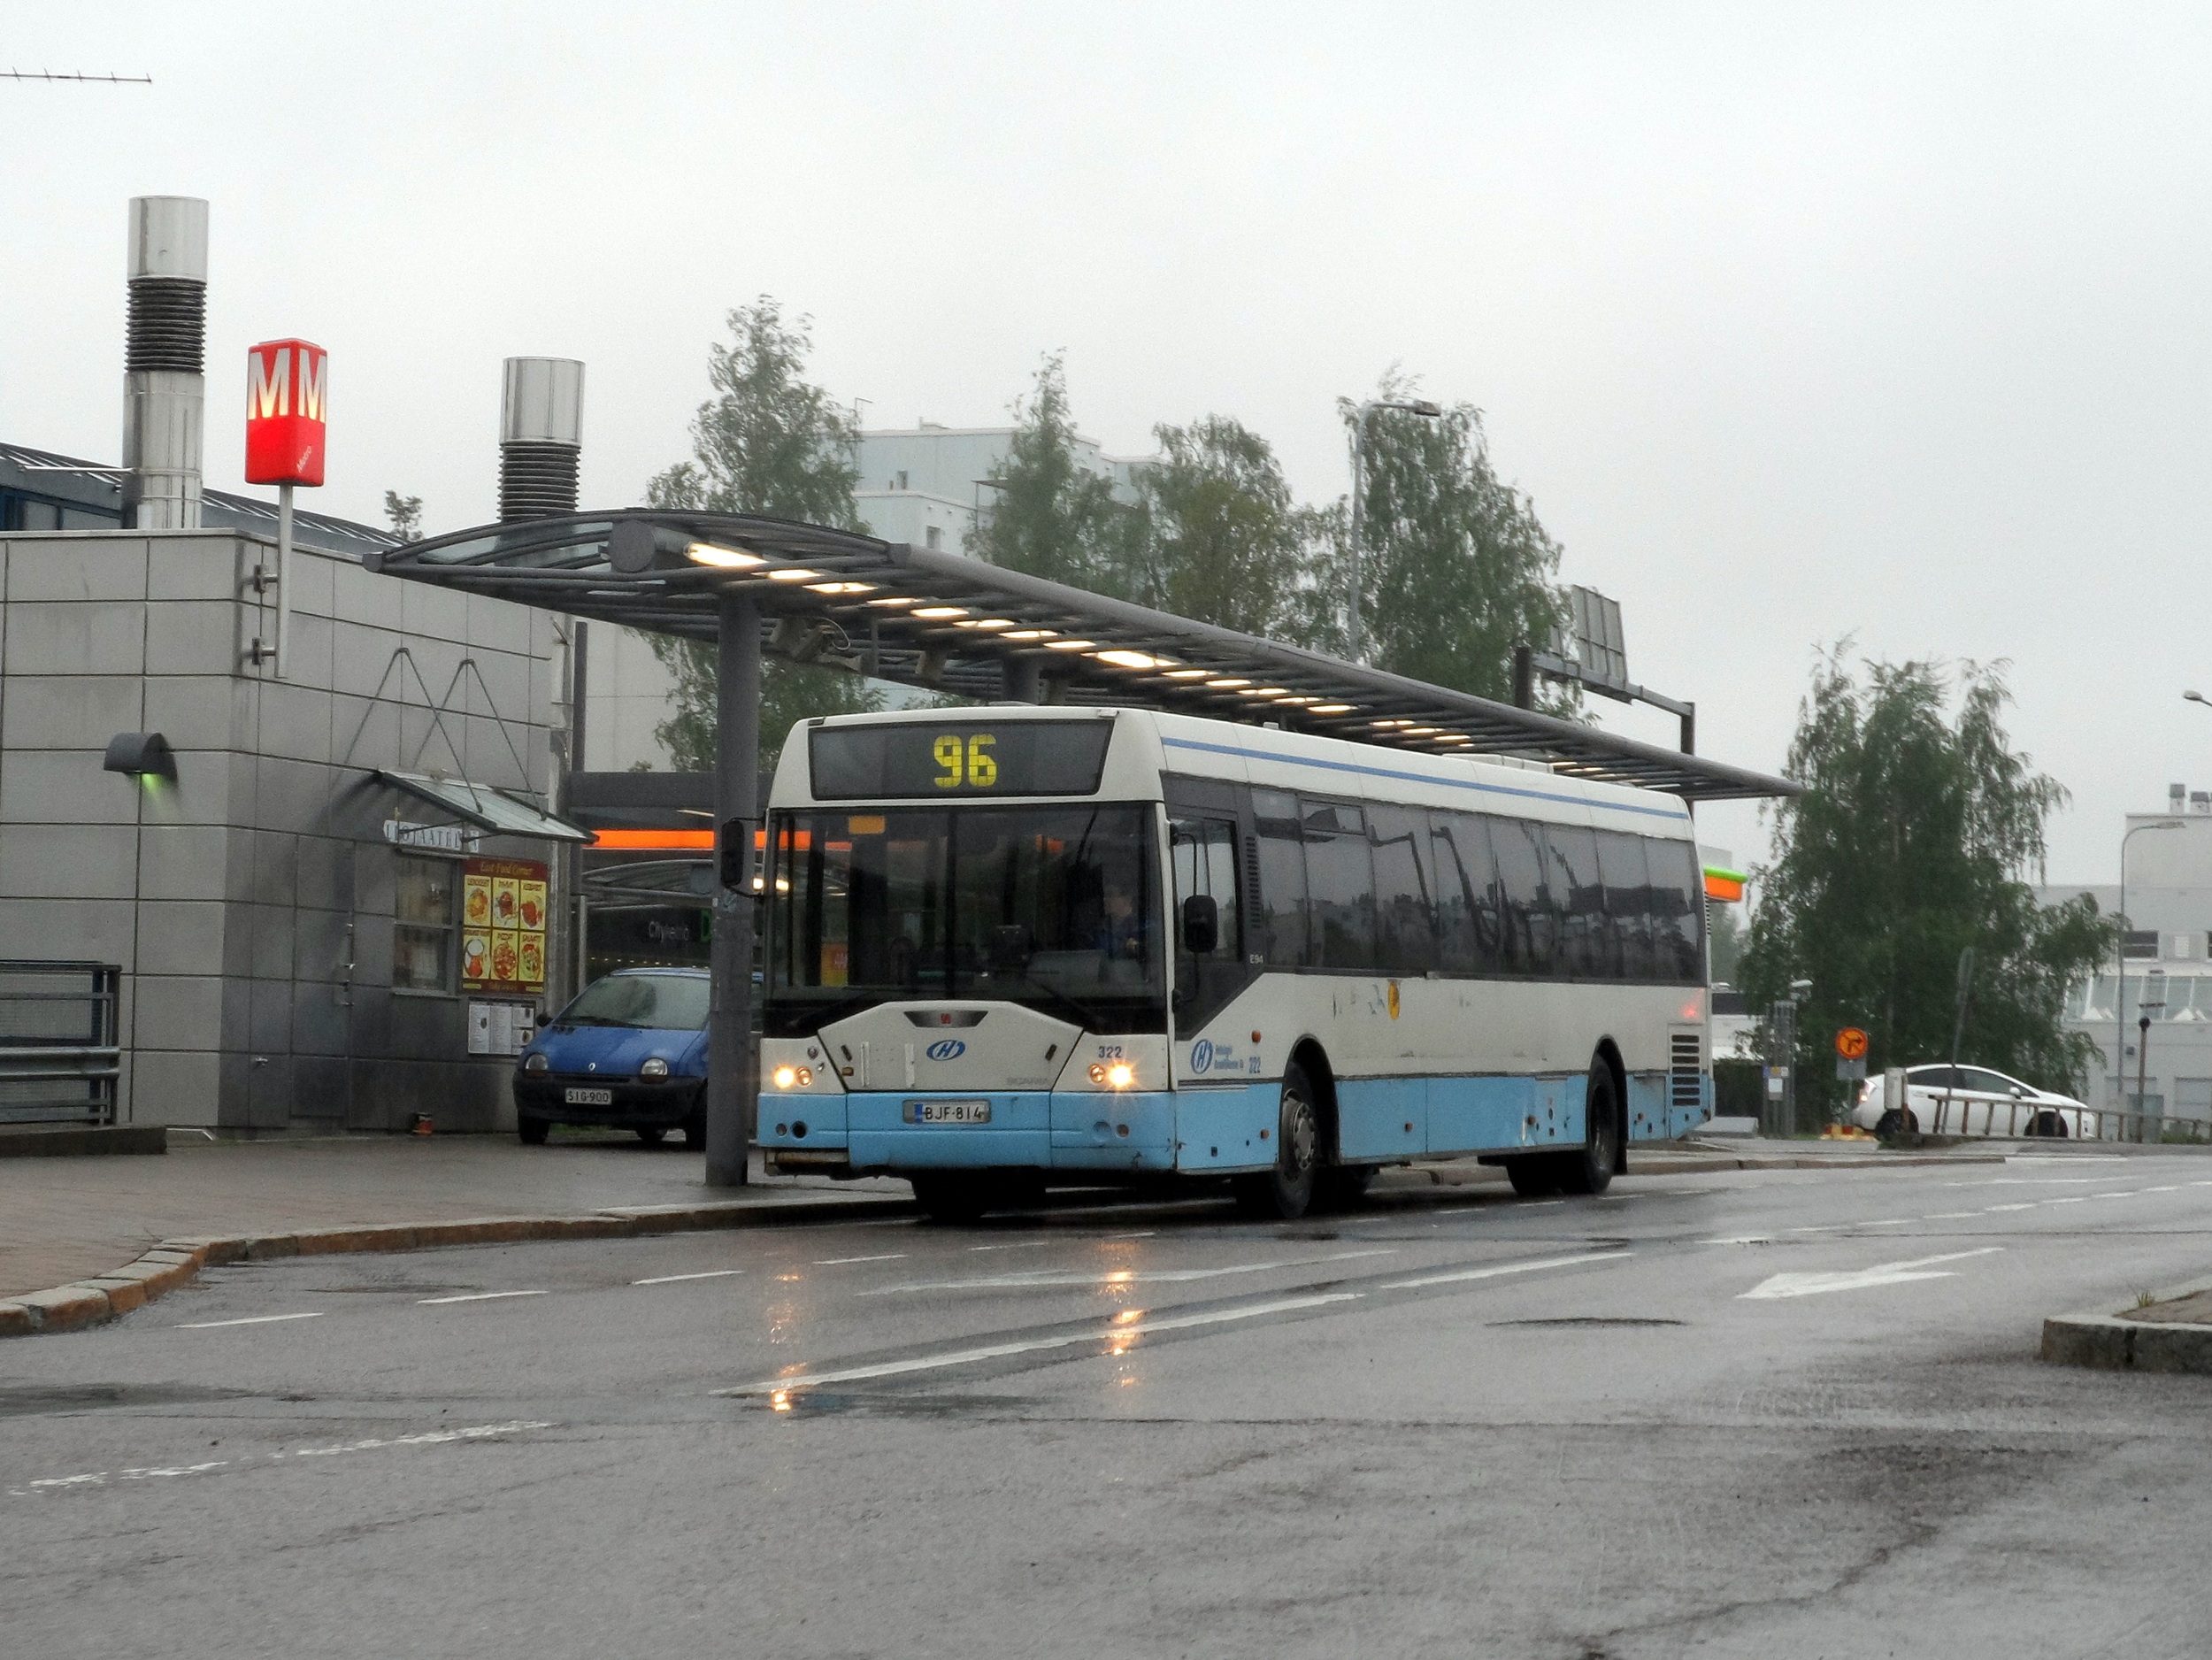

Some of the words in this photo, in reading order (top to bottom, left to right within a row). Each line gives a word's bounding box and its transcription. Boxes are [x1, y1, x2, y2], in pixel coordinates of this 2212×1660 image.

[248, 348, 290, 420] M
[298, 348, 327, 423] M
[296, 445, 312, 473] Metro
[934, 734, 996, 788] 96
[1098, 1046, 1122, 1058] 322
[568, 1090, 609, 1103] SIG-900
[925, 1106, 982, 1120] BJF-814
